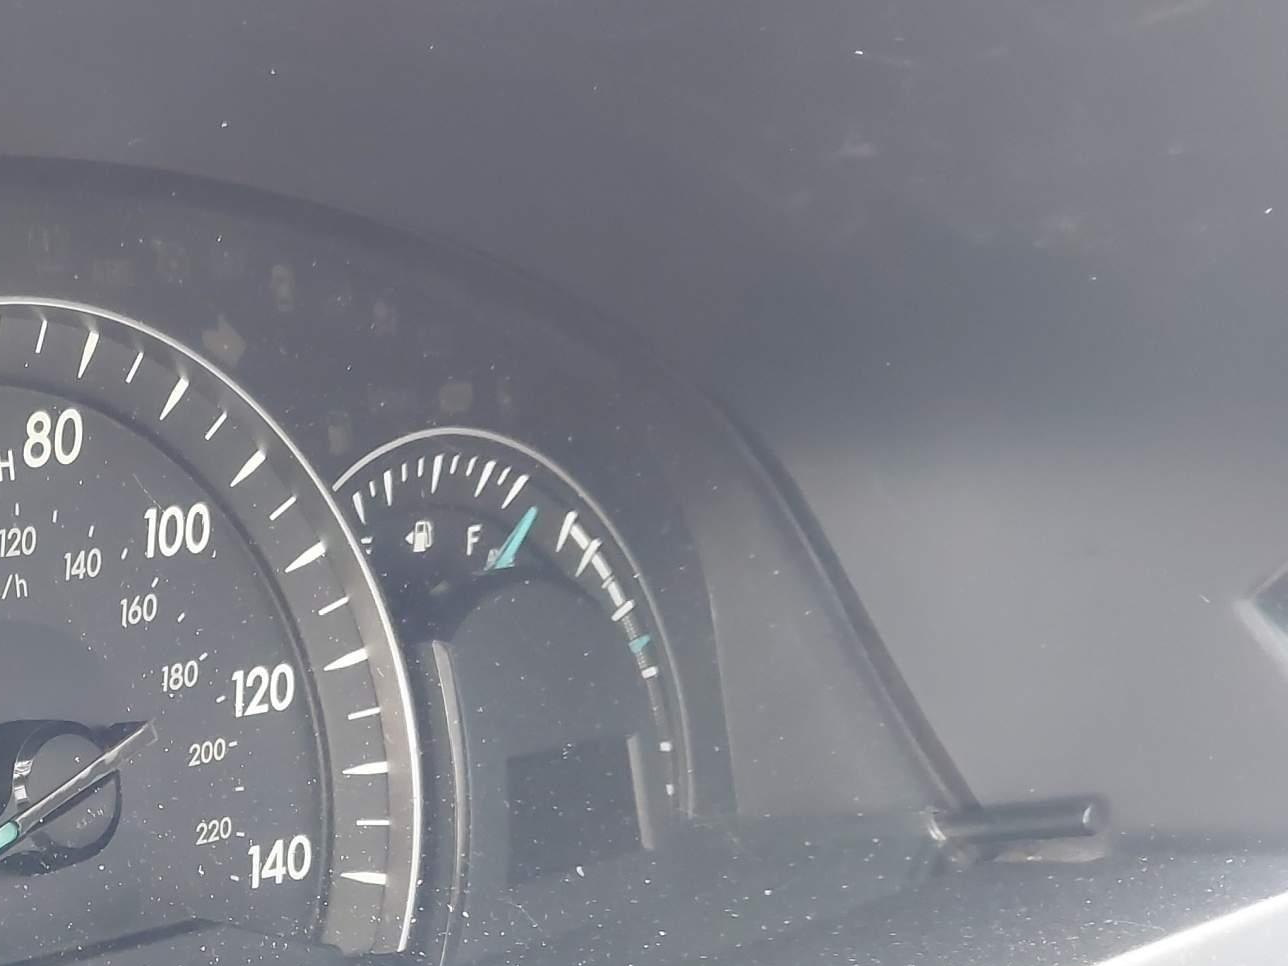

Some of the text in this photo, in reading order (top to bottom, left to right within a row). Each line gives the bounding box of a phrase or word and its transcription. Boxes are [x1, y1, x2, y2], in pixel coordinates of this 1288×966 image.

[23, 407, 83, 466] 80
[144, 503, 211, 559] 100
[466, 524, 482, 556] F
[64, 547, 102, 581] 140
[120, 594, 158, 628] 160
[161, 660, 199, 692] 180
[231, 663, 295, 718] 120
[188, 737, 227, 767] 200
[195, 816, 232, 846] 220
[248, 834, 312, 889] 140
